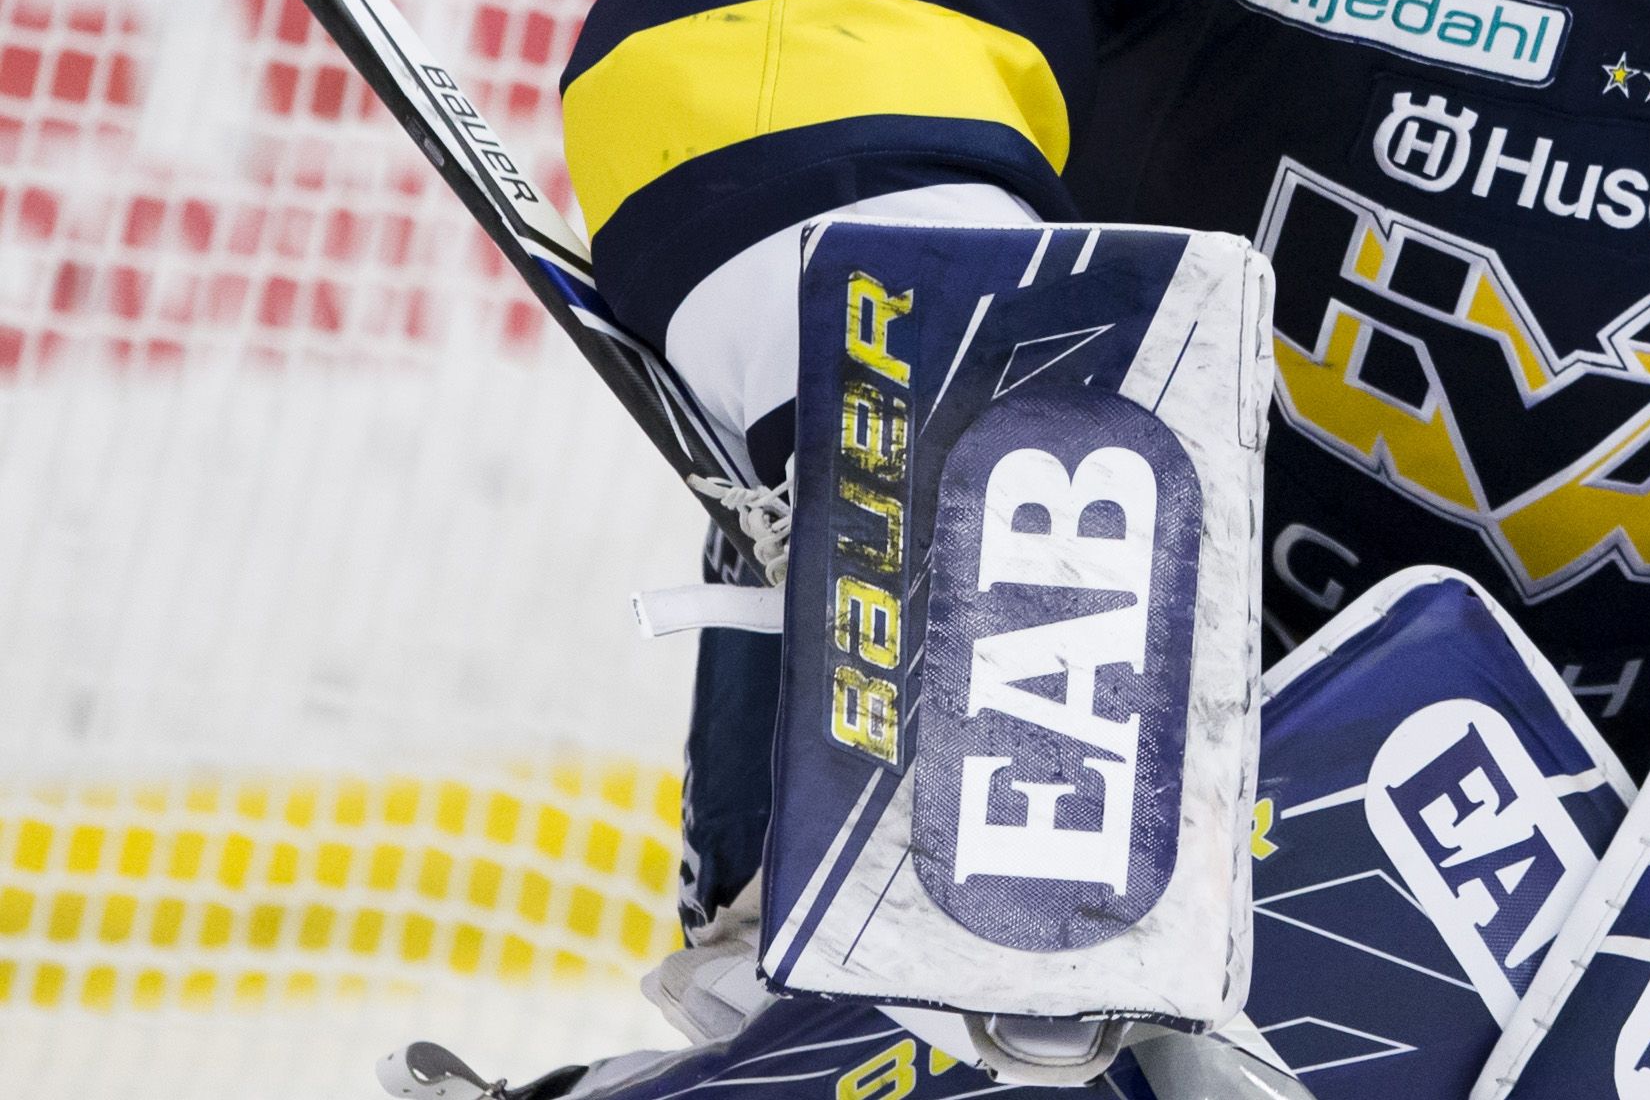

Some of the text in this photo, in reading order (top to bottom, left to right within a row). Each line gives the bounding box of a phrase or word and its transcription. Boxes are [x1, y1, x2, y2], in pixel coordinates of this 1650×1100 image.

[420, 63, 540, 204] BAUER
[830, 269, 915, 766] BAUER
[953, 445, 1159, 896] EAB
